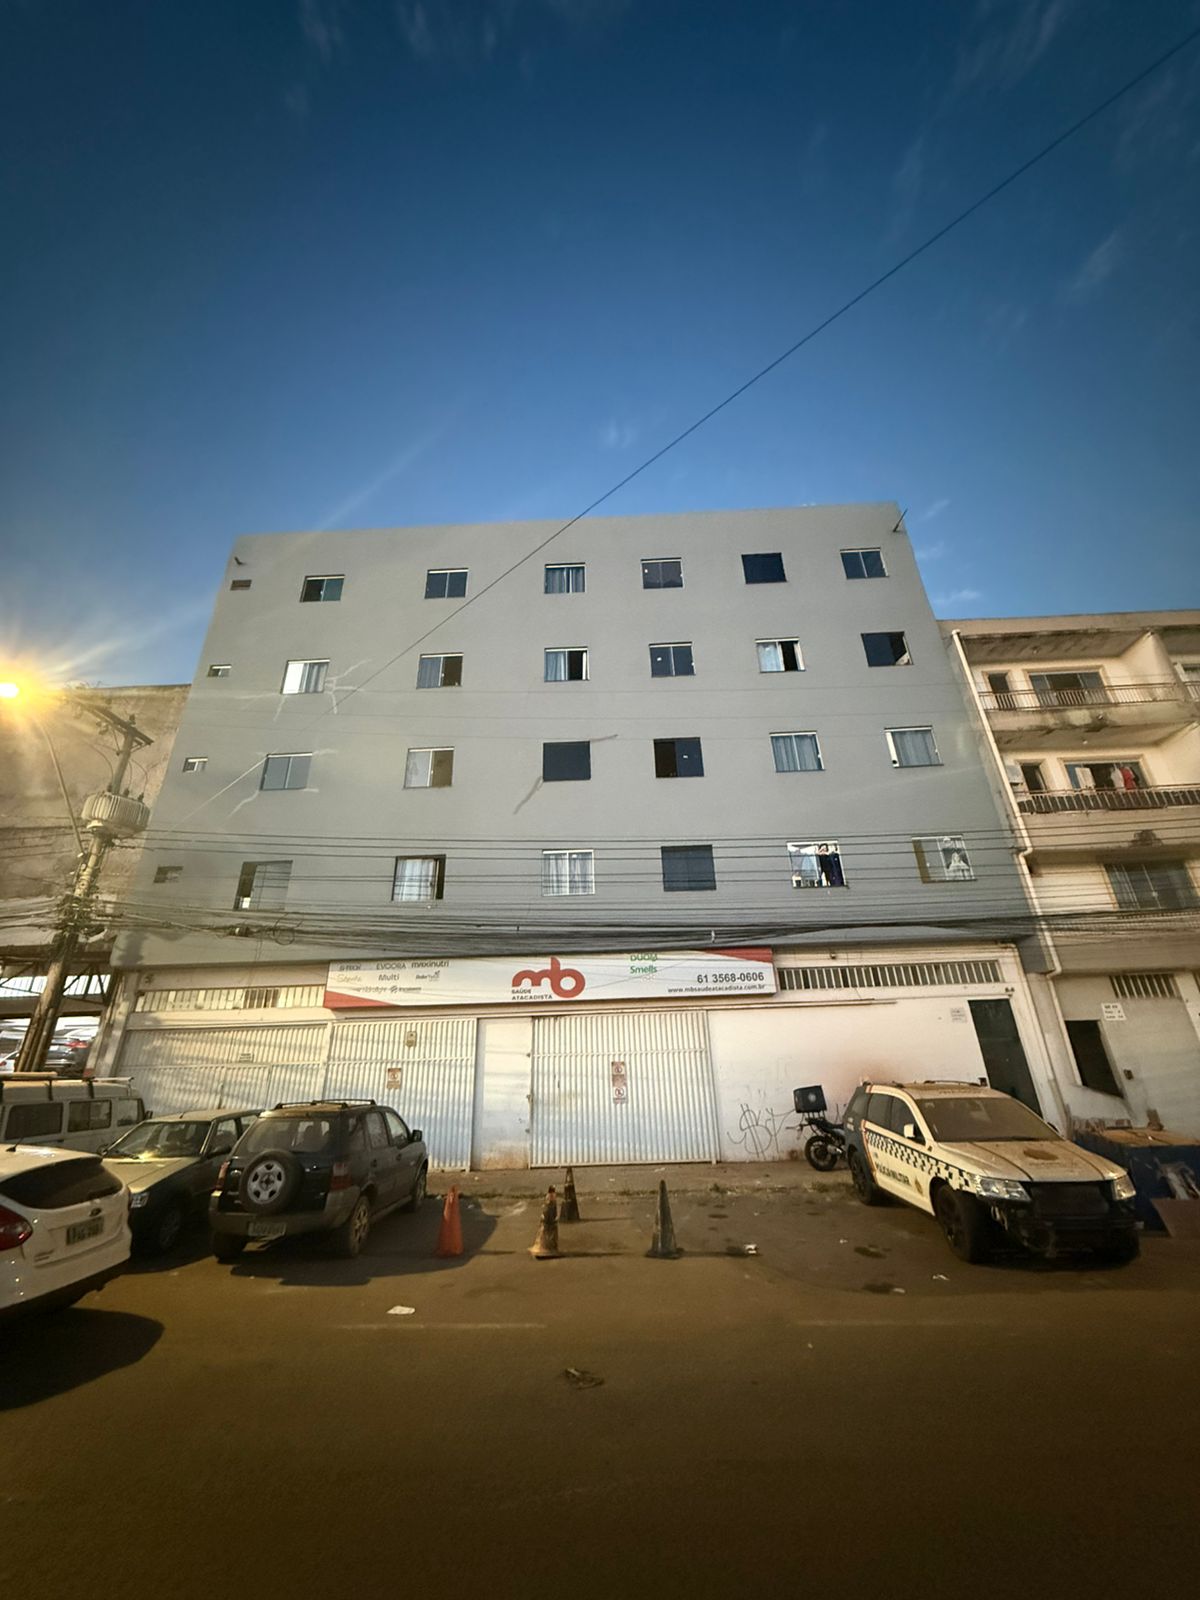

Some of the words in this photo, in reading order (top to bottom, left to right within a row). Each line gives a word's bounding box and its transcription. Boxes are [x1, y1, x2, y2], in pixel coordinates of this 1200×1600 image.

[378, 973, 400, 981] Multi
[697, 974, 708, 984] 61
[712, 972, 764, 983] 3568-0606
